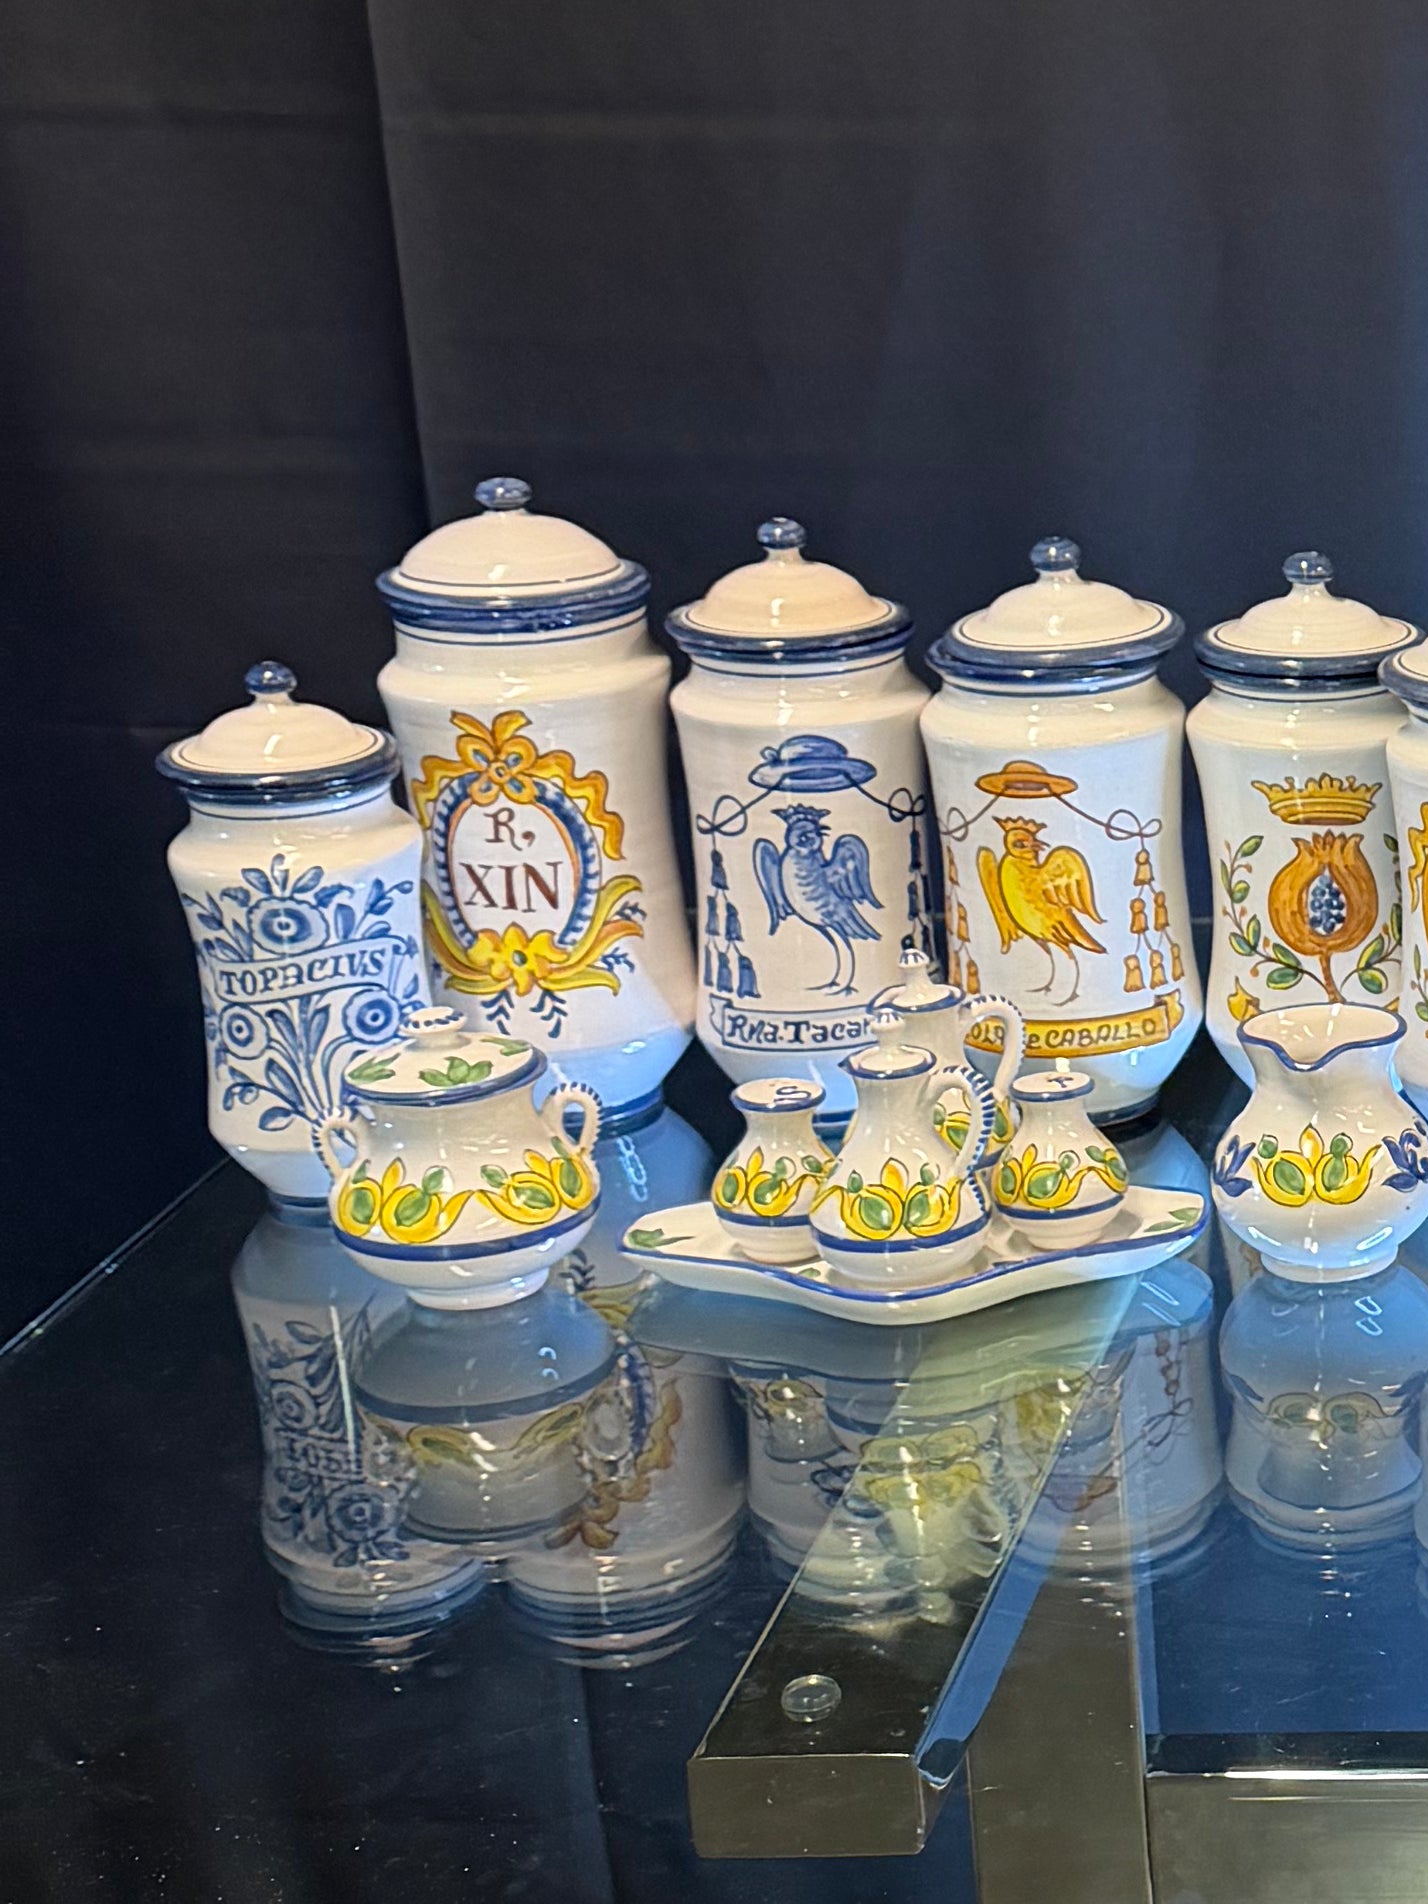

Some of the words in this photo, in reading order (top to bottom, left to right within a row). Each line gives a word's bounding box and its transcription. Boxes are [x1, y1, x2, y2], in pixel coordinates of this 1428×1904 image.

[458, 860, 564, 914] XIN
[970, 1022, 1005, 1046] OLA
[1044, 1018, 1157, 1049] CABALLO
